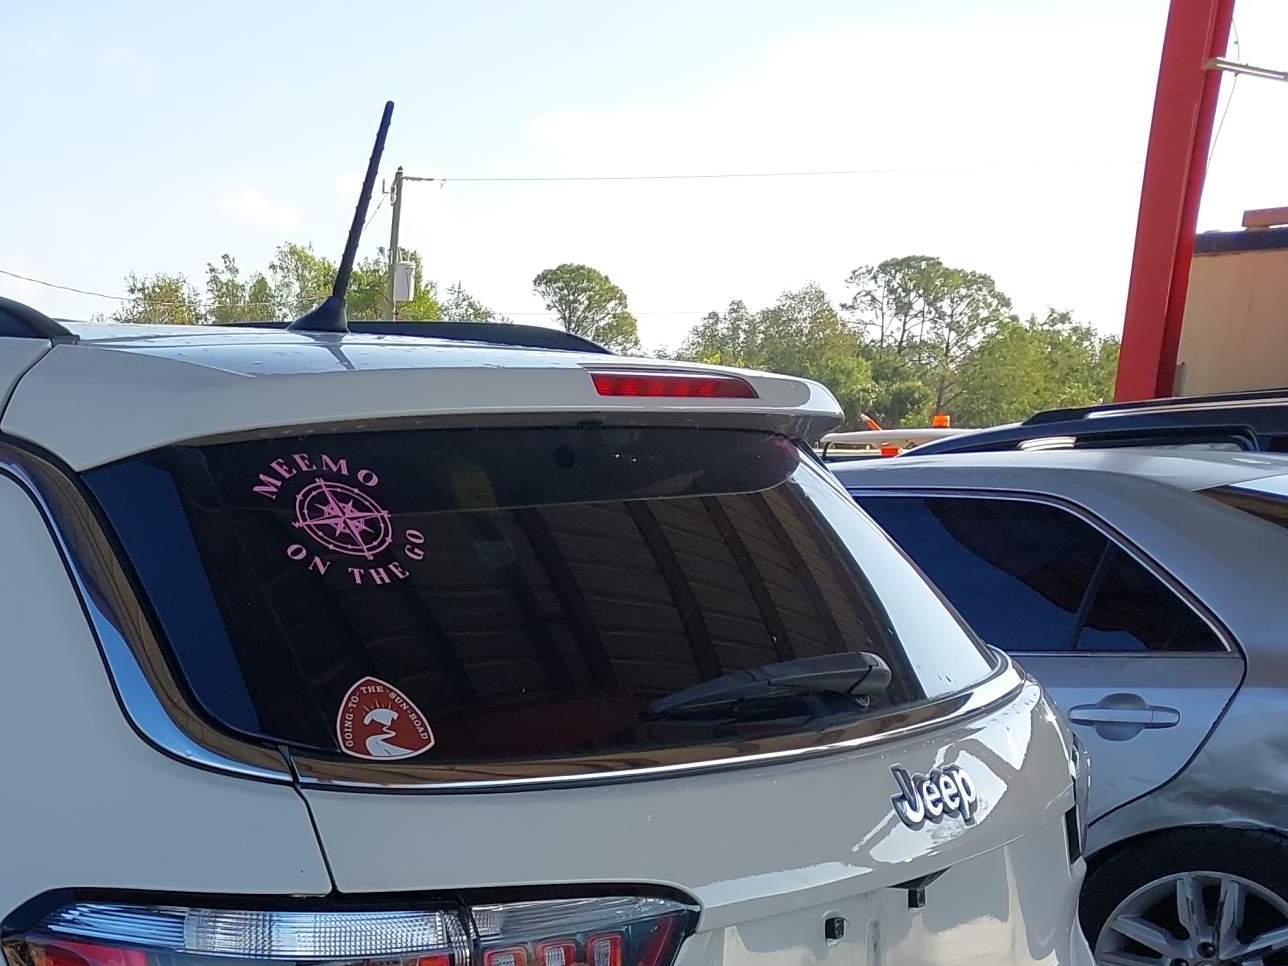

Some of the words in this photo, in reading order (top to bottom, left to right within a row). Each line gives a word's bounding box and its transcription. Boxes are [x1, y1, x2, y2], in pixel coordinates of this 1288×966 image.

[252, 453, 379, 500] MEEMO
[286, 544, 331, 576] ON
[347, 561, 410, 585] THE
[404, 529, 425, 560] GO
[890, 763, 978, 831] Jeep
